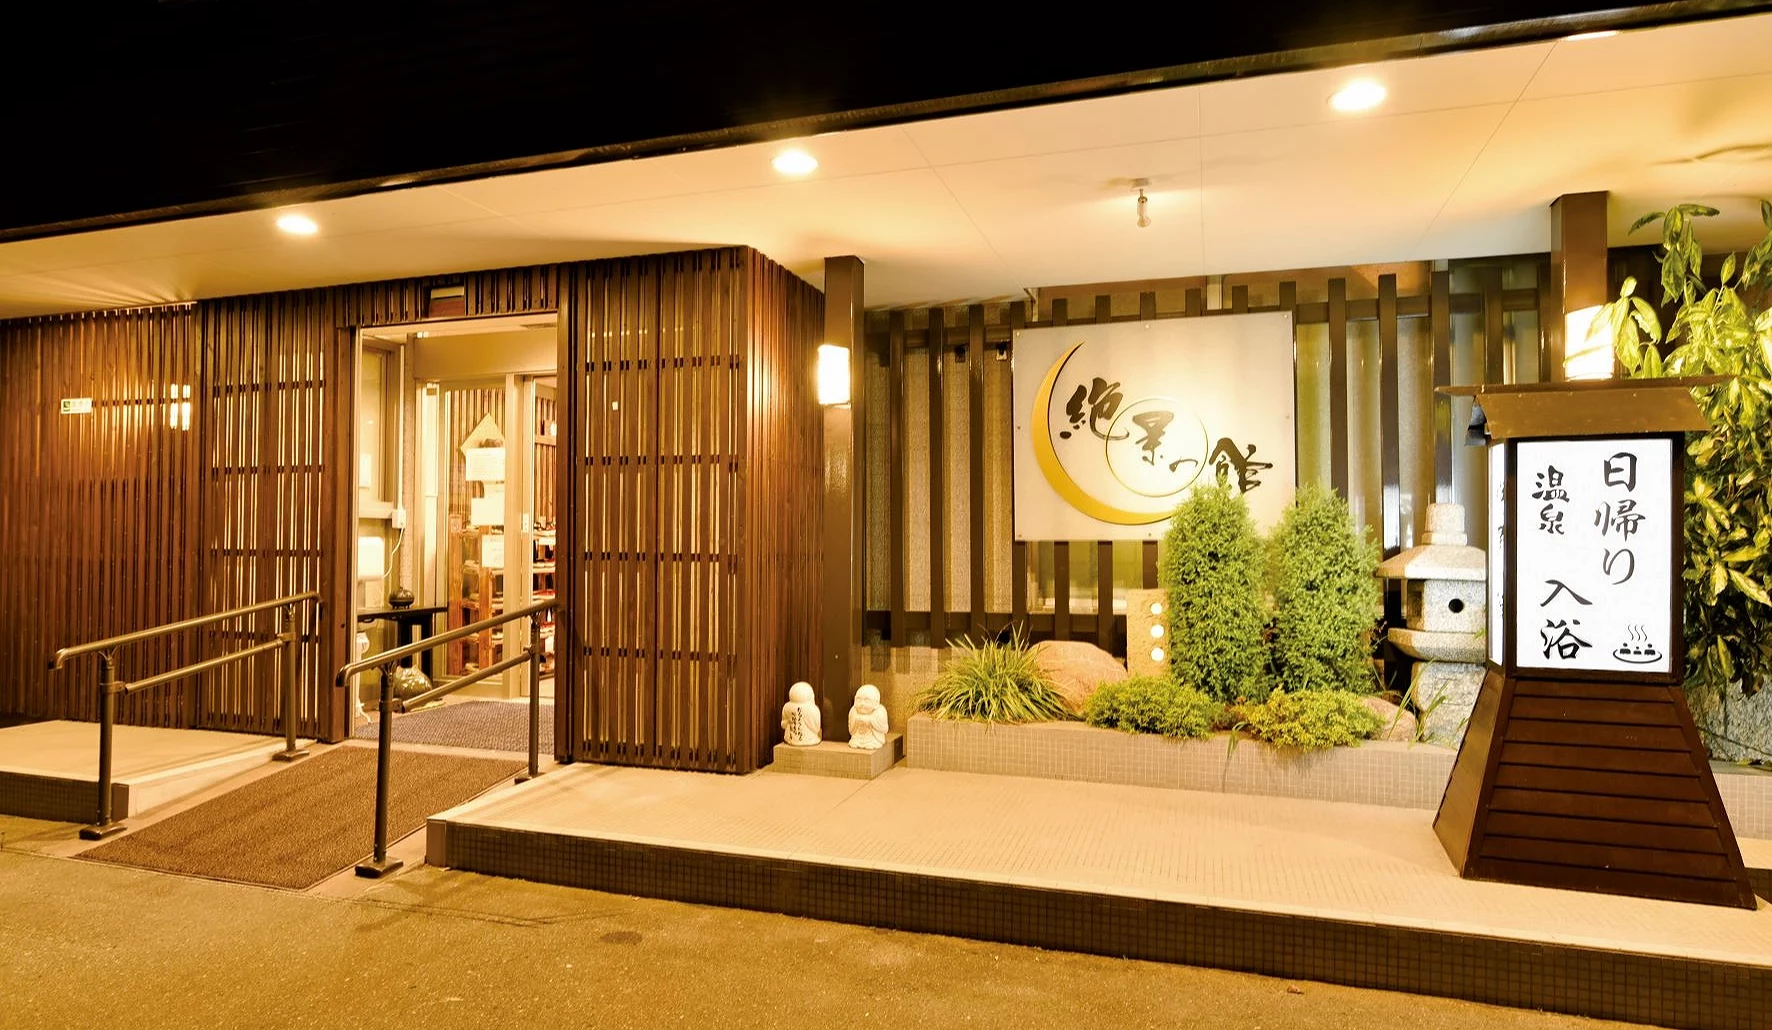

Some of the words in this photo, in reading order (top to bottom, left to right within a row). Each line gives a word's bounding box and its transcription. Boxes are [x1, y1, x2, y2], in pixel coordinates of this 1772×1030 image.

[1531, 465, 1570, 535] 温泉
[1594, 452, 1646, 586] 日帰り
[1540, 579, 1593, 660] 入浴
